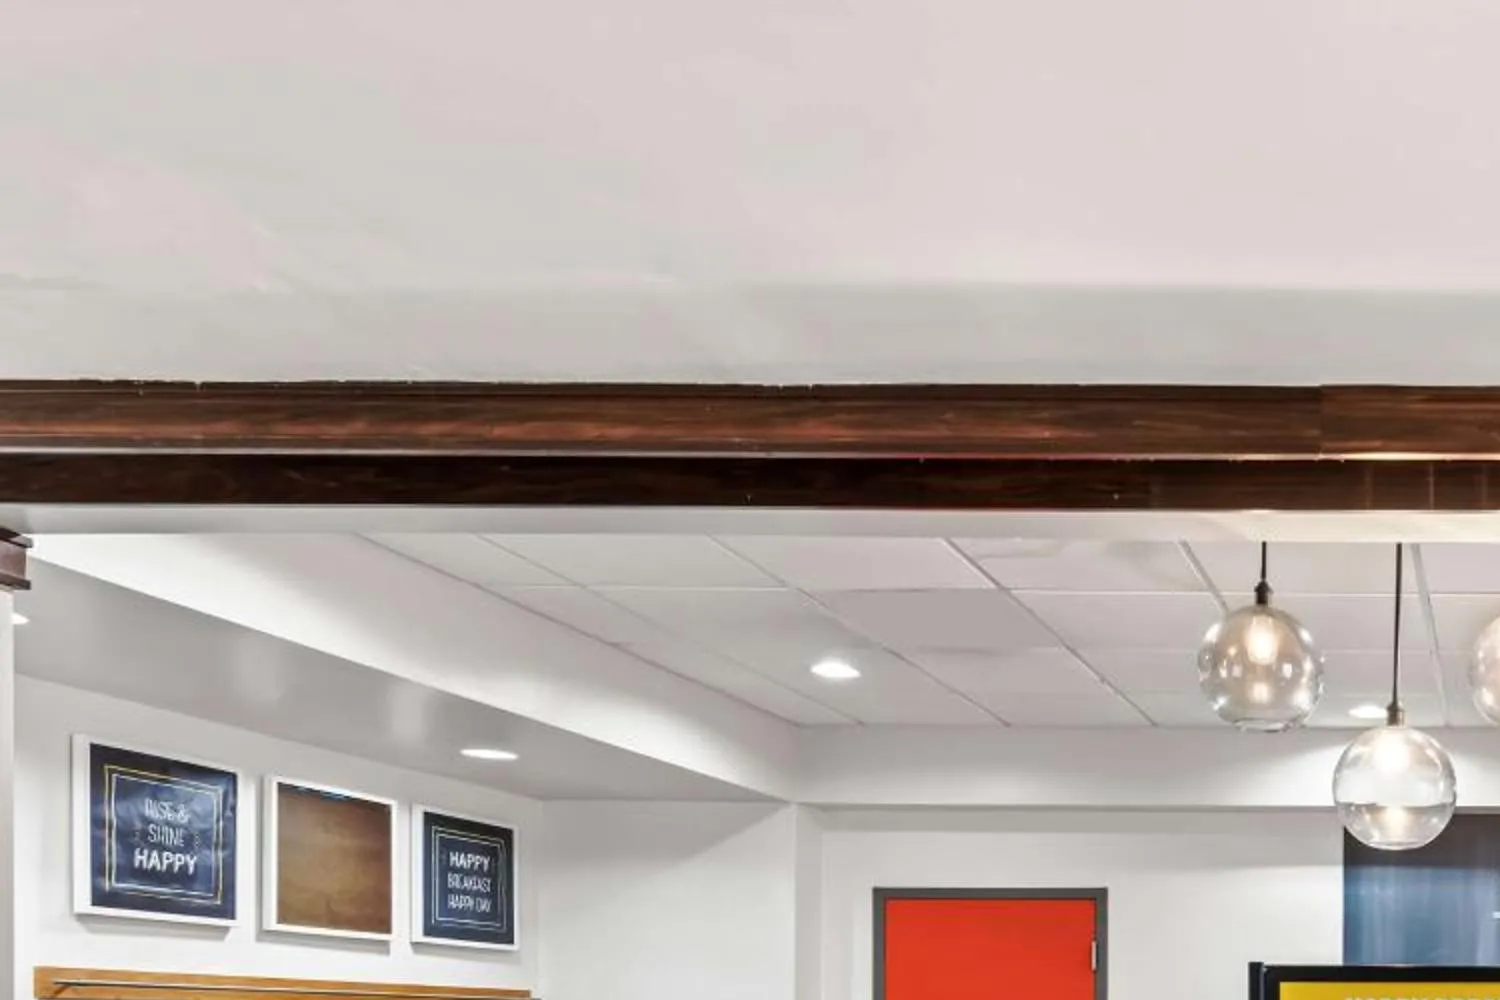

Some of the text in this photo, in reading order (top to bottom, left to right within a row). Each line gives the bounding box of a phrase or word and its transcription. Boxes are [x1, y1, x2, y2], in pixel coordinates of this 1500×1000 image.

[147, 823, 185, 847] SHINE
[134, 847, 198, 876] HAPPY
[449, 851, 491, 872] HAPPY
